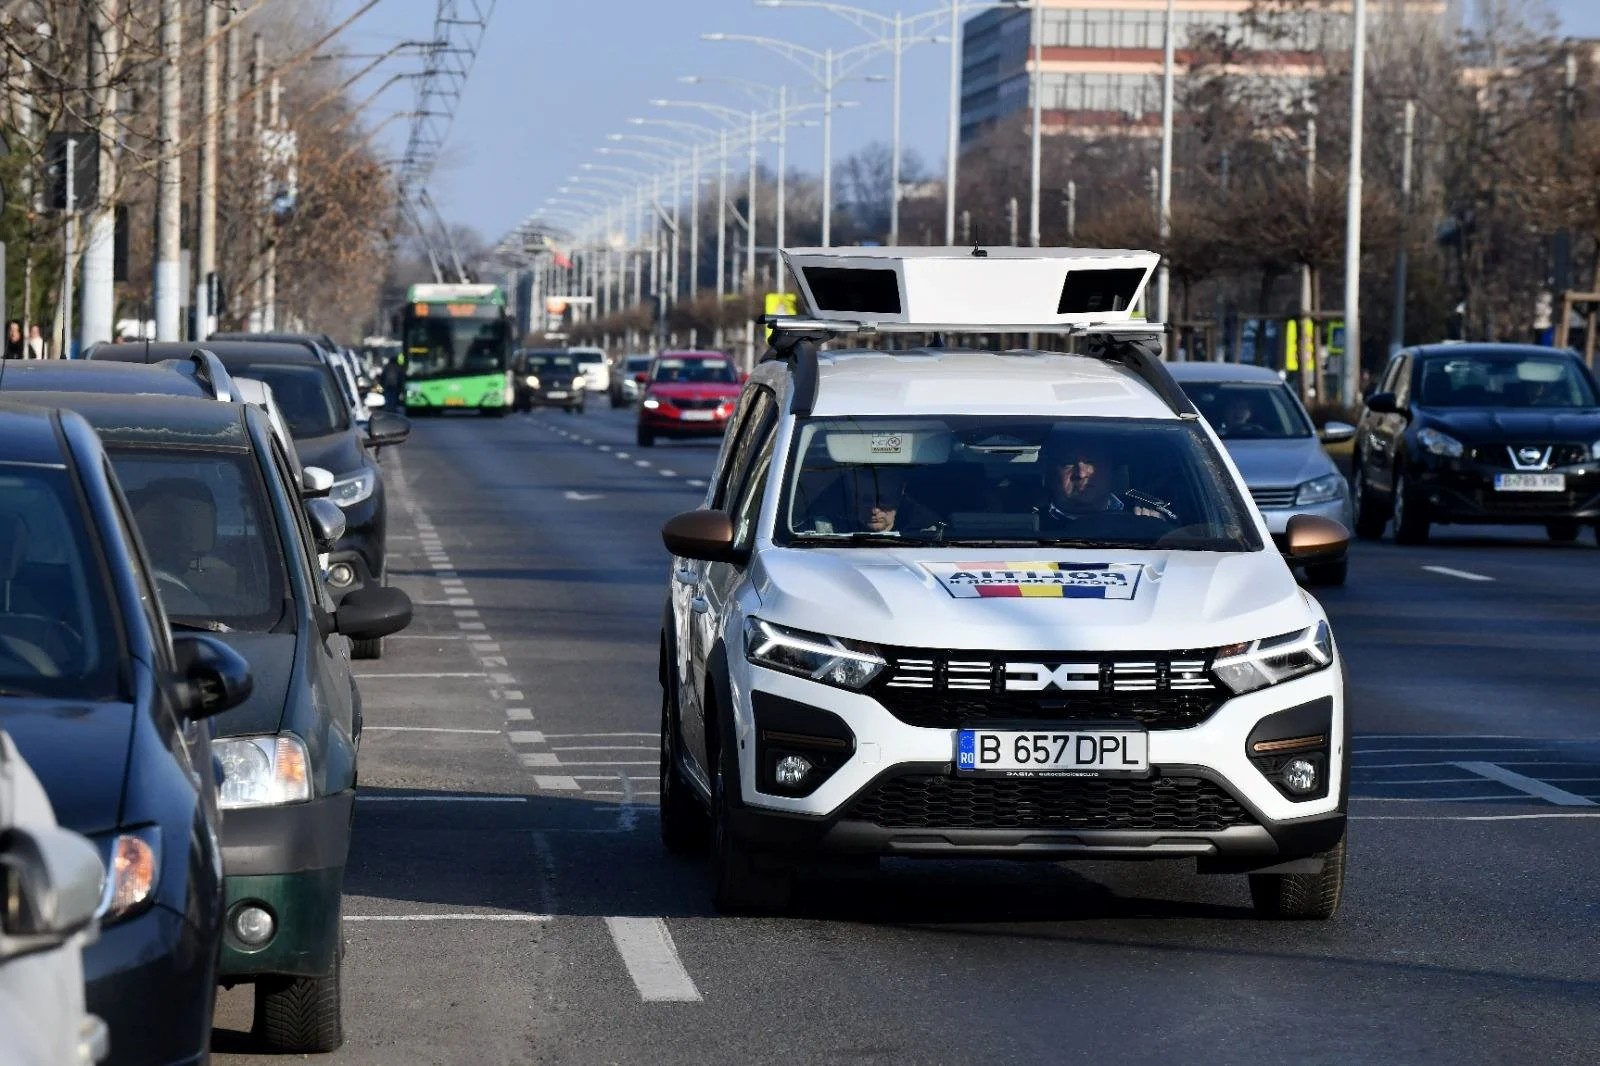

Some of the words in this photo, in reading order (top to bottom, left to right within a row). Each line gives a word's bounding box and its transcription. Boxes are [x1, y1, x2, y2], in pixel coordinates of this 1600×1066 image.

[961, 752, 973, 764] RO
[980, 735, 1001, 763] B
[1014, 735, 1070, 764] 657
[1076, 735, 1139, 765] DPL
